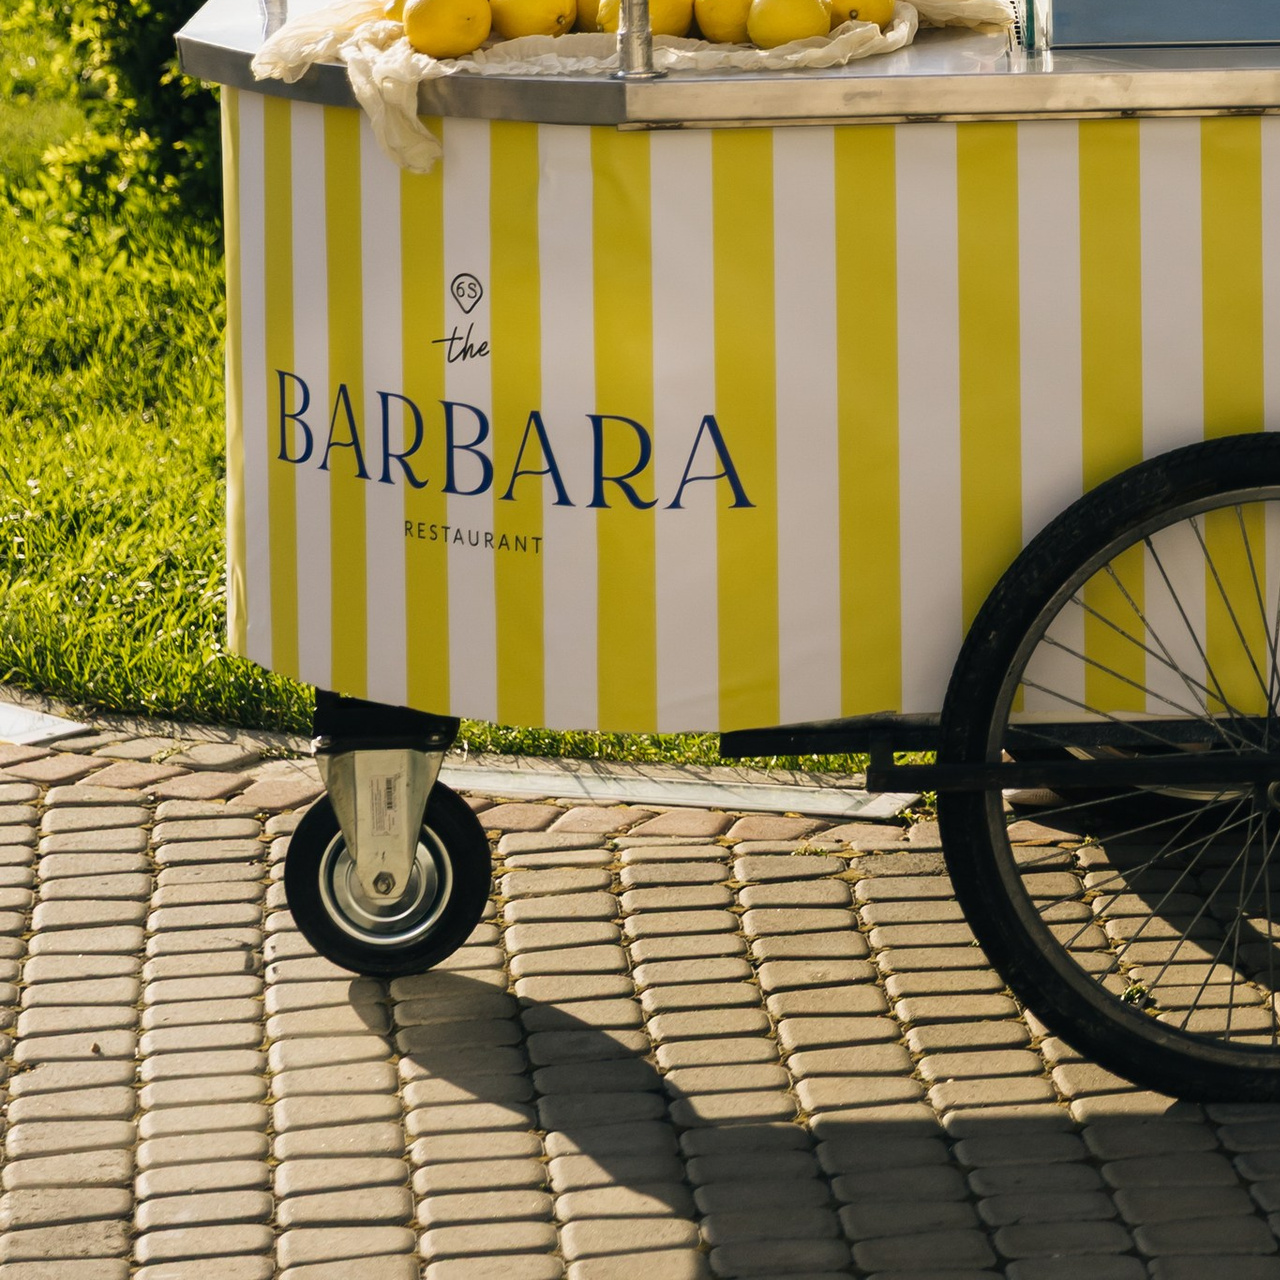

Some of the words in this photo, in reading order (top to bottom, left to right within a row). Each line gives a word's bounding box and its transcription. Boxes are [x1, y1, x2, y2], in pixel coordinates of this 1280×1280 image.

[432, 323, 490, 363] the
[275, 369, 756, 510] BARBARA
[404, 520, 543, 554] RESTAURANT
